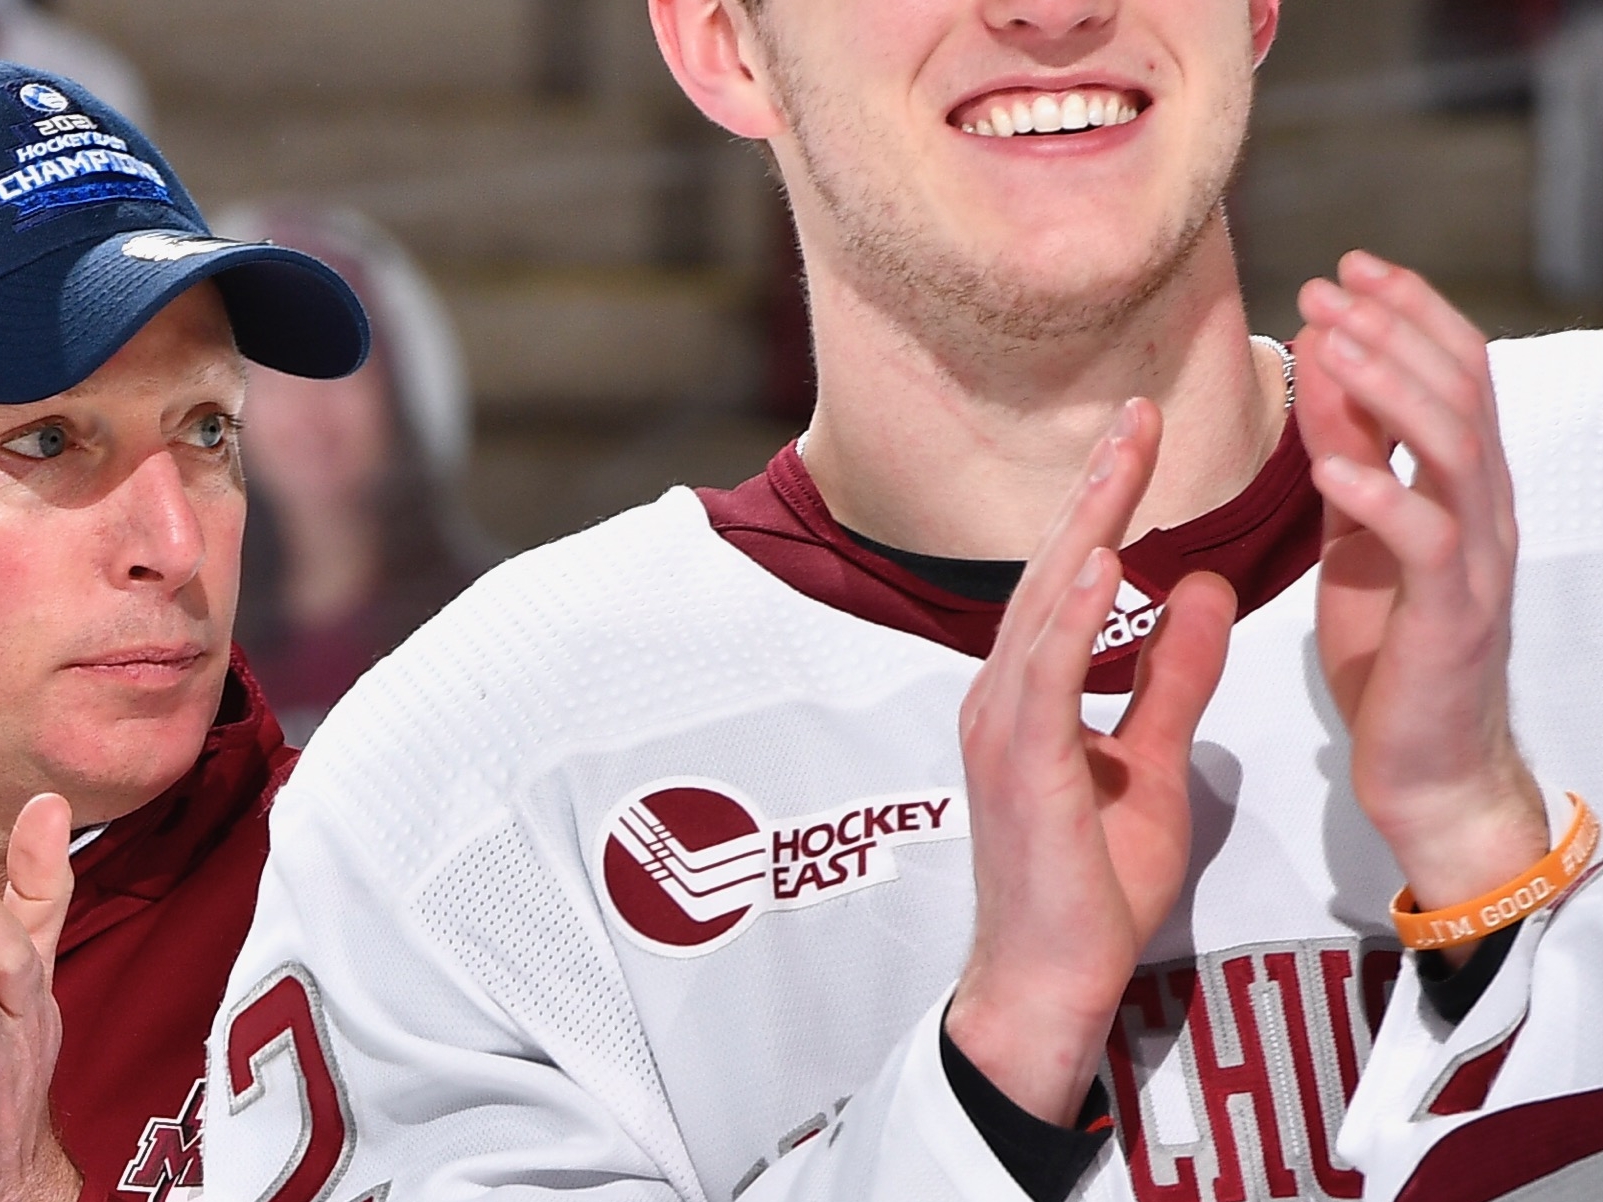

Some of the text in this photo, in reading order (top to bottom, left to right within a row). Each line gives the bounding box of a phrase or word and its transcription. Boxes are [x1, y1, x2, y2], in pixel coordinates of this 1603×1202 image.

[15, 131, 93, 164] HOCKEY
[772, 797, 952, 865] HOCKEY
[773, 840, 878, 901] EAST
